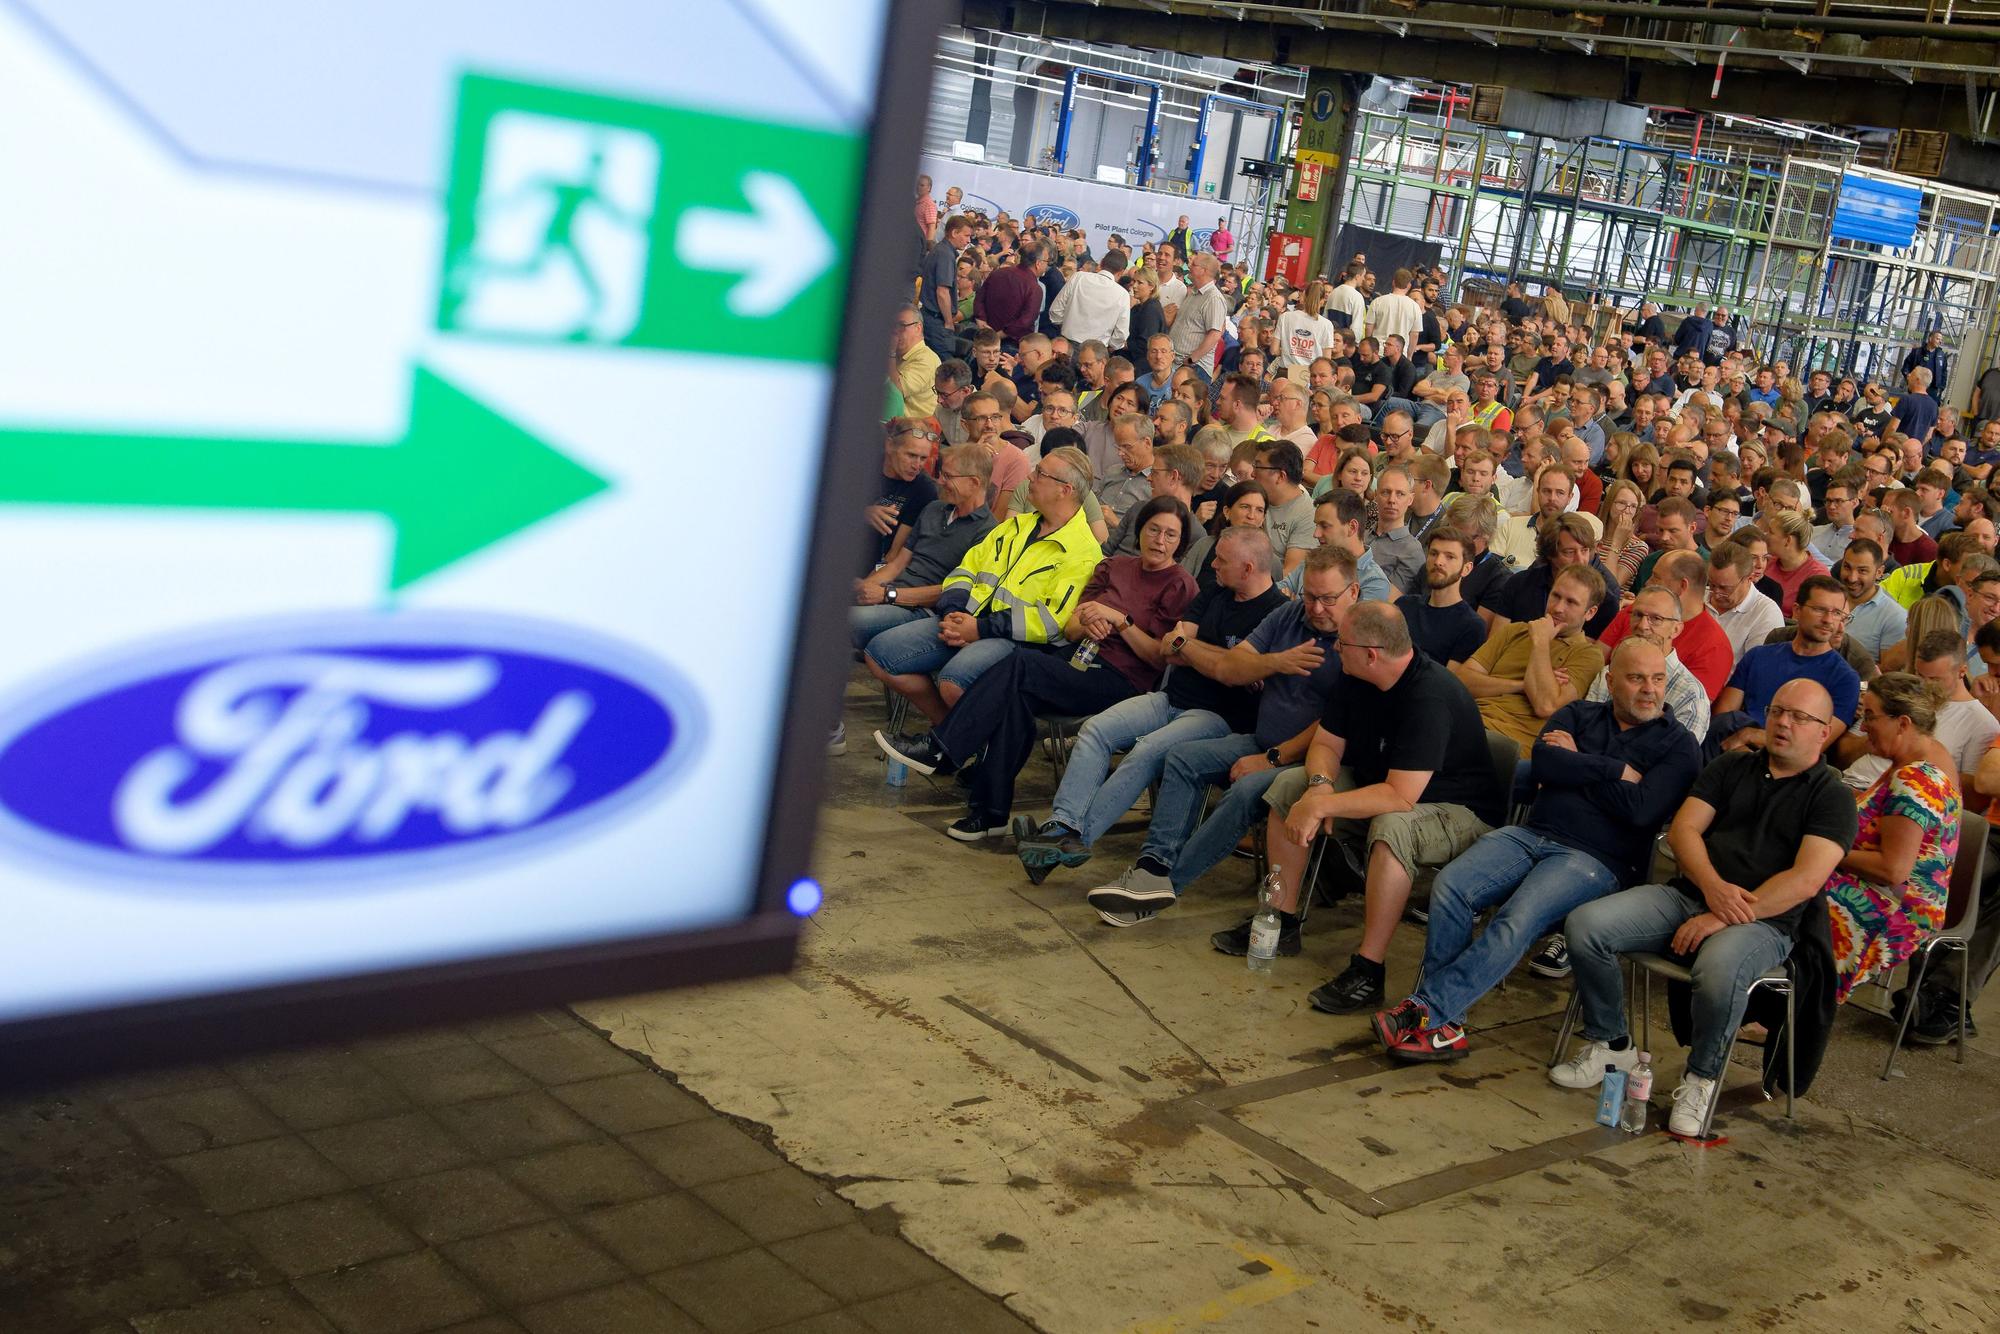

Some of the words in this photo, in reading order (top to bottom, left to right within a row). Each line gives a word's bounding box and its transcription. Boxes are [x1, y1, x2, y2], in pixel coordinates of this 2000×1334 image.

[1035, 207, 1071, 229] Ford
[1095, 223, 1110, 231] Pilot
[1112, 225, 1129, 234] Plant
[1130, 228, 1154, 238] Cologne
[1291, 336, 1315, 349] STOP
[113, 654, 594, 855] Ford
